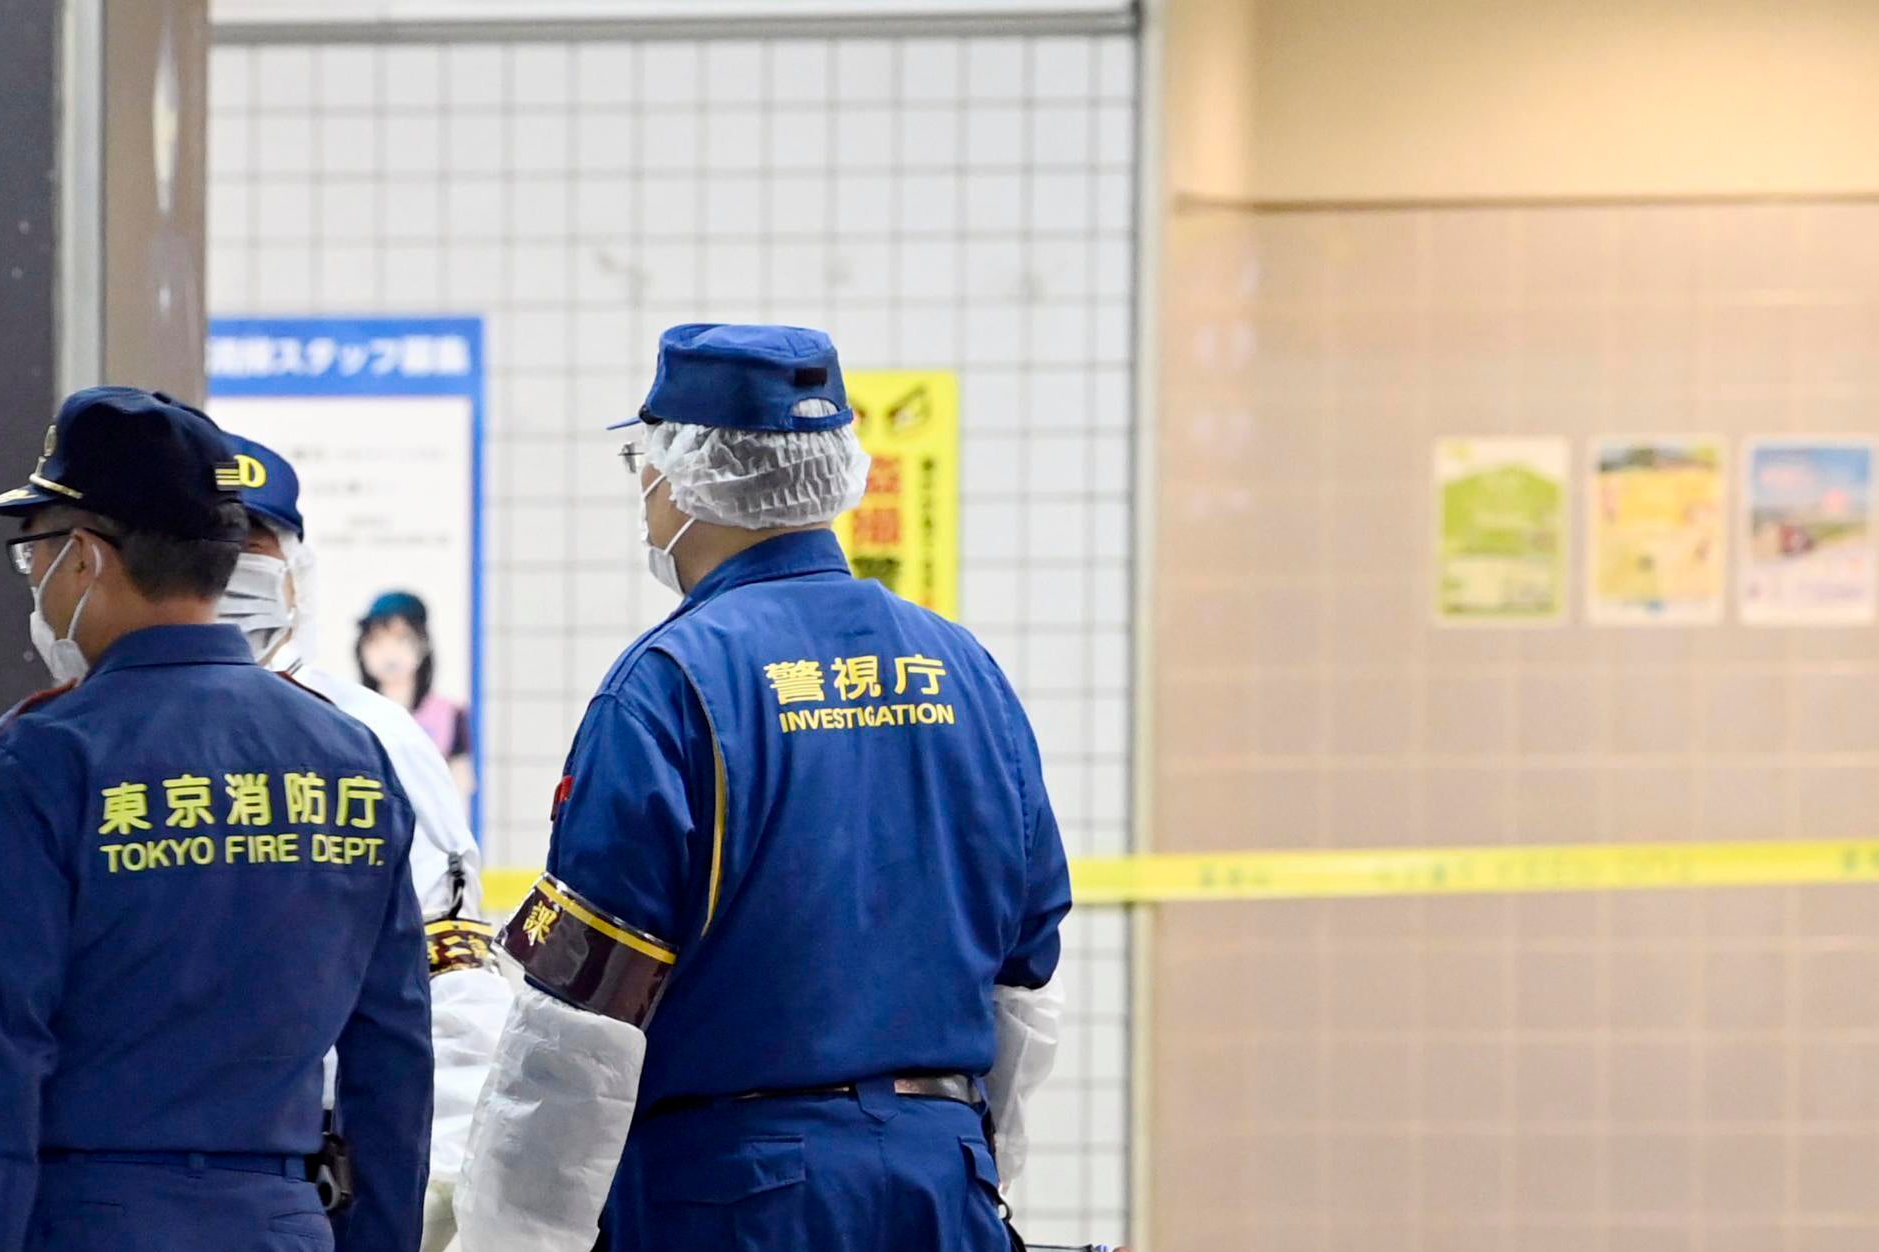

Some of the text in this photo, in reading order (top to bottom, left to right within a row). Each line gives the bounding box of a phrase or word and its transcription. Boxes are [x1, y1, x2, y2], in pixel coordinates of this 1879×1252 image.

[763, 654, 947, 705] 警視庁
[778, 703, 955, 734] INVESTIGATION
[98, 773, 384, 835] 東京消防庁
[99, 833, 385, 873] TOKYO FIRE DEPT.
